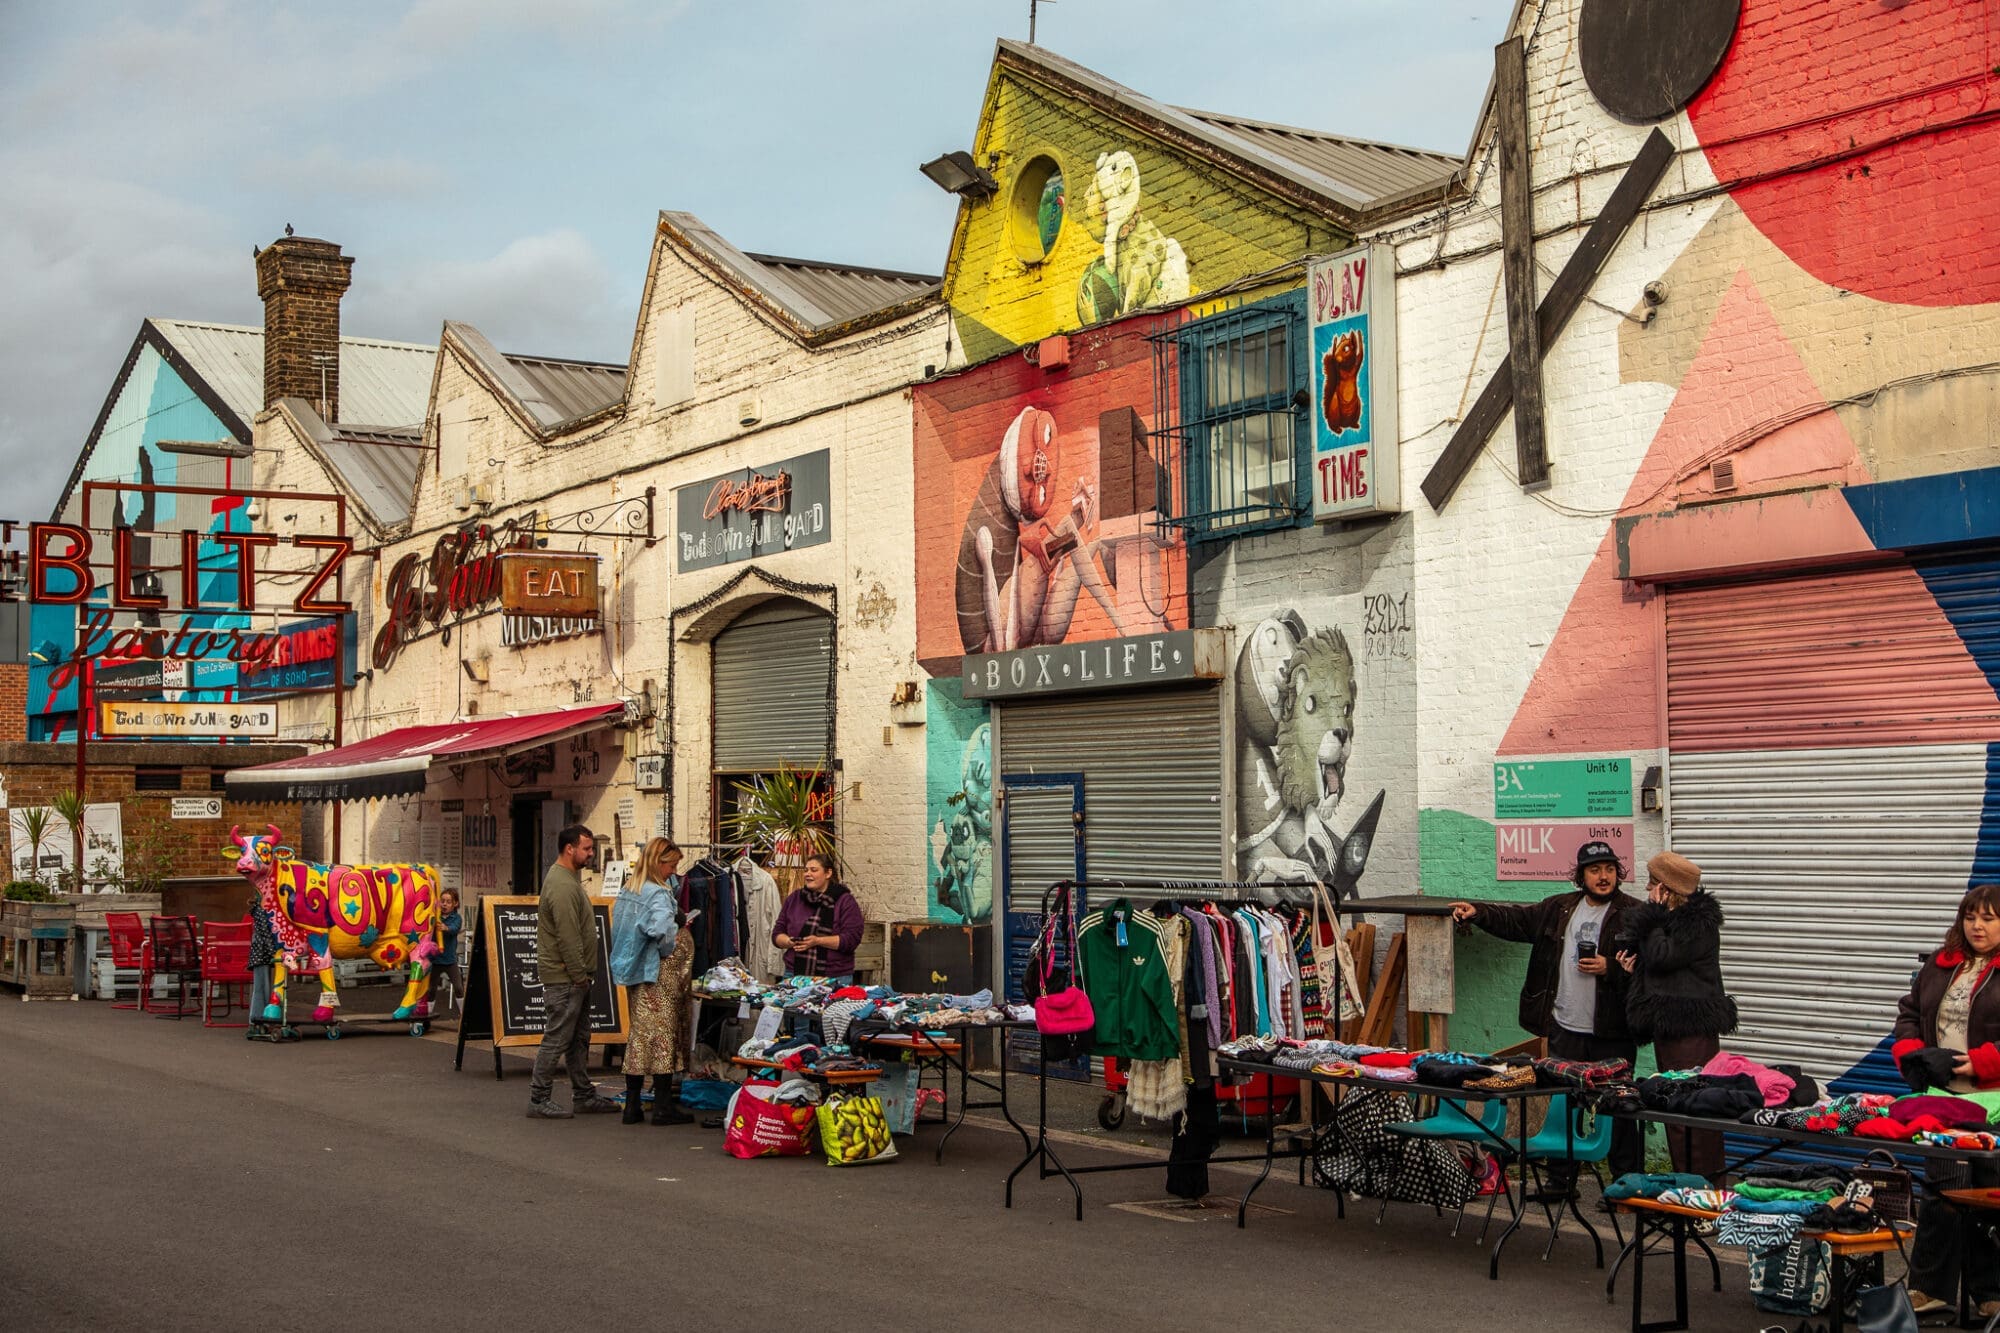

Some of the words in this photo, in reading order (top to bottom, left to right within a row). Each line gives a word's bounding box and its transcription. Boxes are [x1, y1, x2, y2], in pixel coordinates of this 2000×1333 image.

[1315, 257, 1367, 322] PLAY
[29, 521, 353, 612] BLITZ
[526, 569, 586, 597] EAT
[499, 616, 594, 647] MUSEUM
[48, 608, 283, 690] factory
[164, 659, 184, 674] BOSCH
[986, 652, 1053, 690] BOX
[1079, 639, 1167, 682] LIFE
[285, 670, 307, 685] SOHO
[639, 761, 661, 773] STUDIO
[1586, 762, 1606, 774] Unit
[1608, 762, 1619, 773] 16
[646, 775, 653, 786] 12
[1589, 827, 1609, 838] Unit
[1611, 827, 1622, 837] 16
[1500, 827, 1556, 854] MILK
[1500, 856, 1528, 864] Furniture
[278, 863, 436, 936] LOVE
[755, 1120, 784, 1134] Flowers,
[758, 1113, 786, 1126] Lemons,
[751, 1135, 782, 1147] Peppers.
